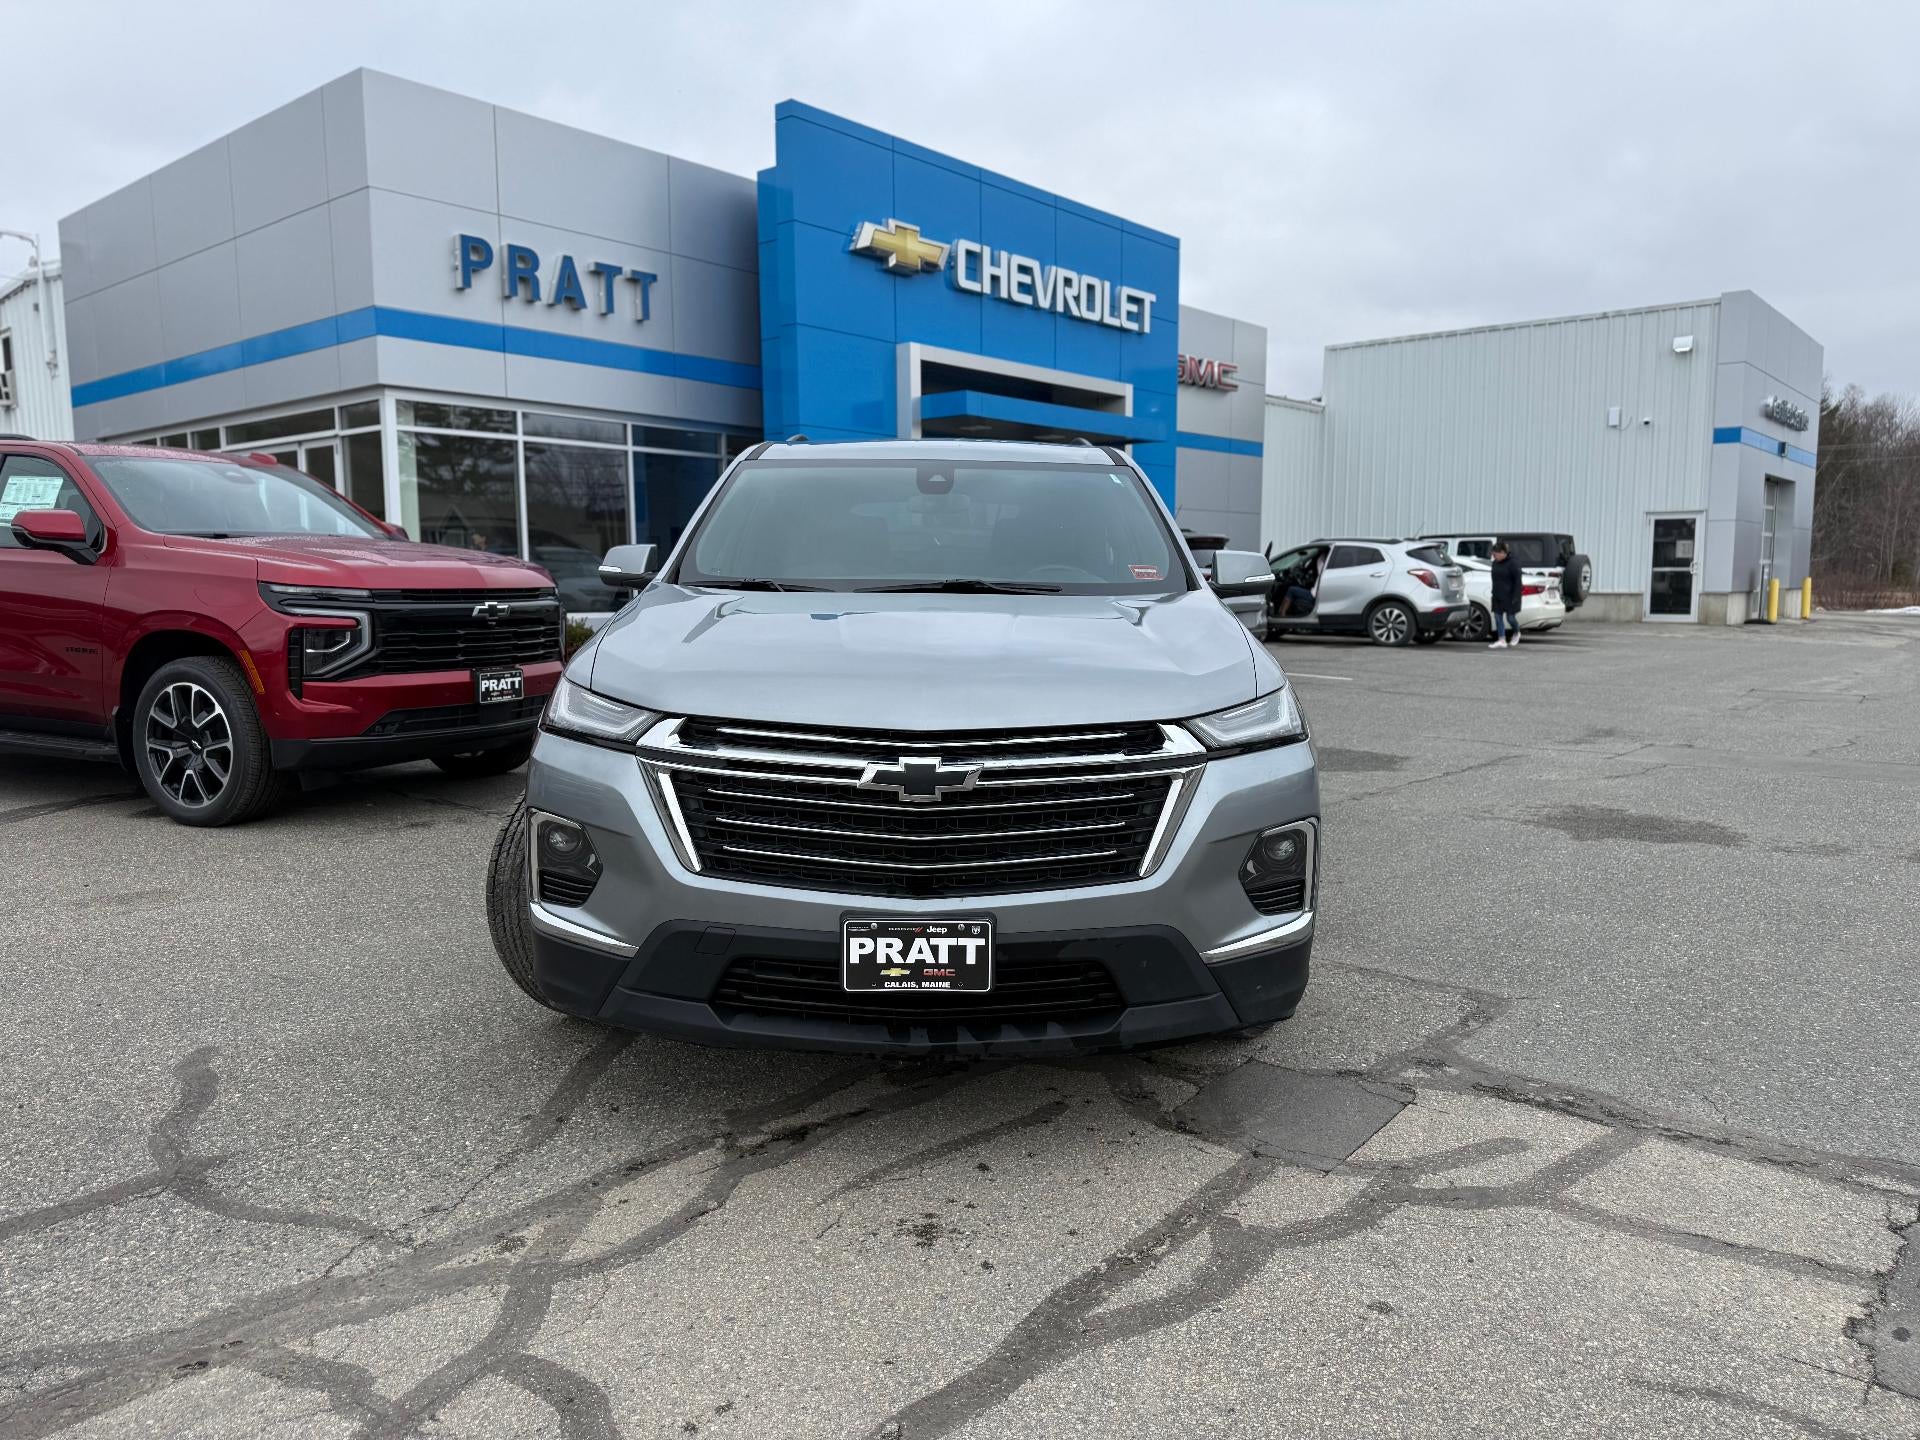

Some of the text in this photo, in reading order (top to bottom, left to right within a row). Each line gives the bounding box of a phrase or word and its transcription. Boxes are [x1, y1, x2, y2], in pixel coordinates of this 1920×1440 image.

[455, 233, 658, 321] PRATT
[953, 238, 1157, 334] CHEVROLET
[1178, 353, 1239, 391] MC
[481, 677, 521, 691] PRATT
[926, 925, 948, 935] Jeep
[849, 937, 986, 965] PRATT
[923, 968, 956, 977] GMC
[884, 981, 951, 989] CALAIS, MAINE
